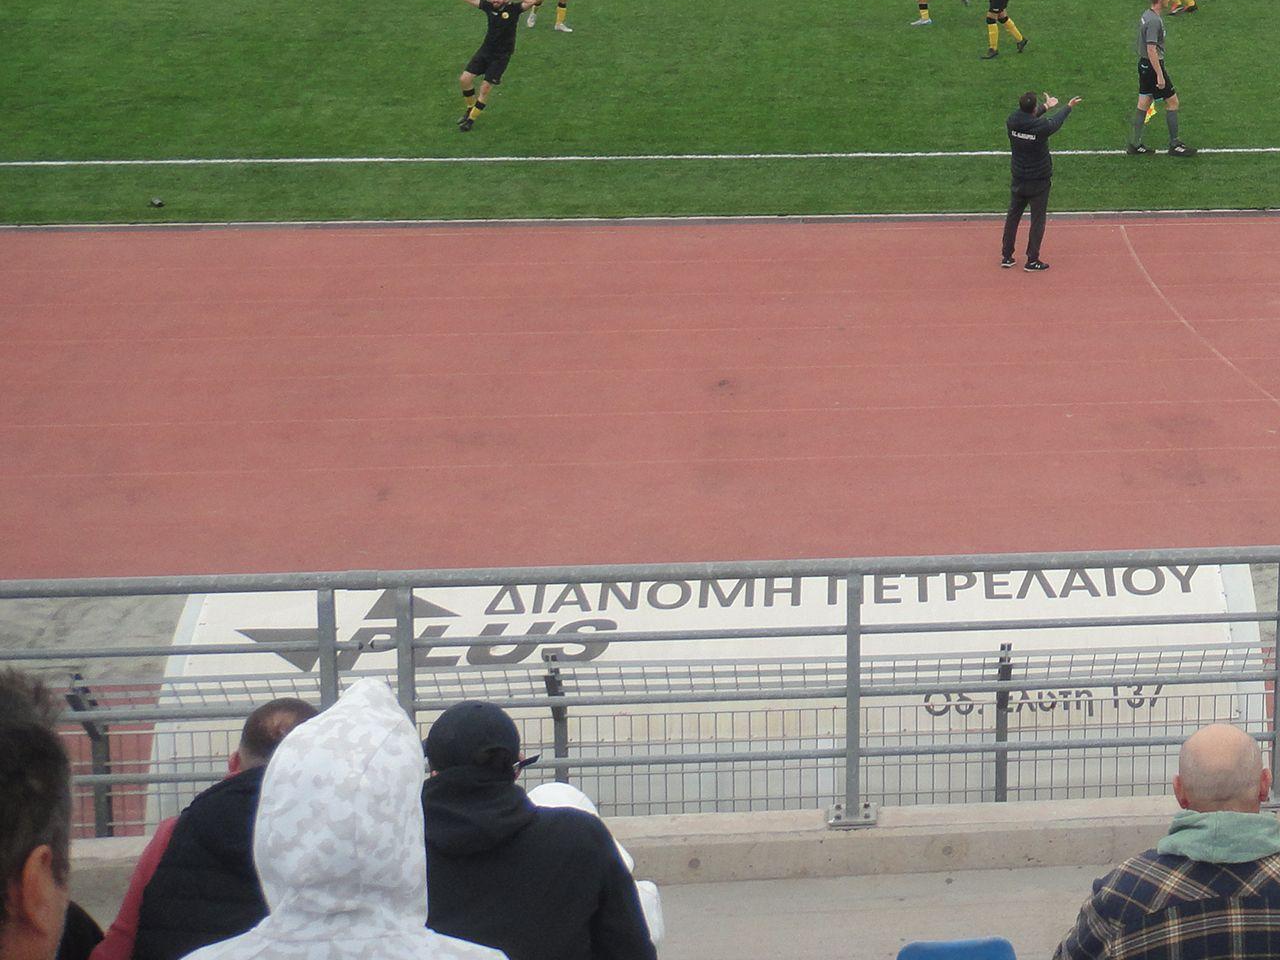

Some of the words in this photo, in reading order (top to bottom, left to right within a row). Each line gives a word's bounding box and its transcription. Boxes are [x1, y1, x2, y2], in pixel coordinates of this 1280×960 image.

[484, 577, 801, 616] ΔΙΑΝΟΜΗ
[826, 564, 1199, 606] ΠΕΤΡΕΛΑΙΟΥ
[338, 619, 618, 667] PLUS
